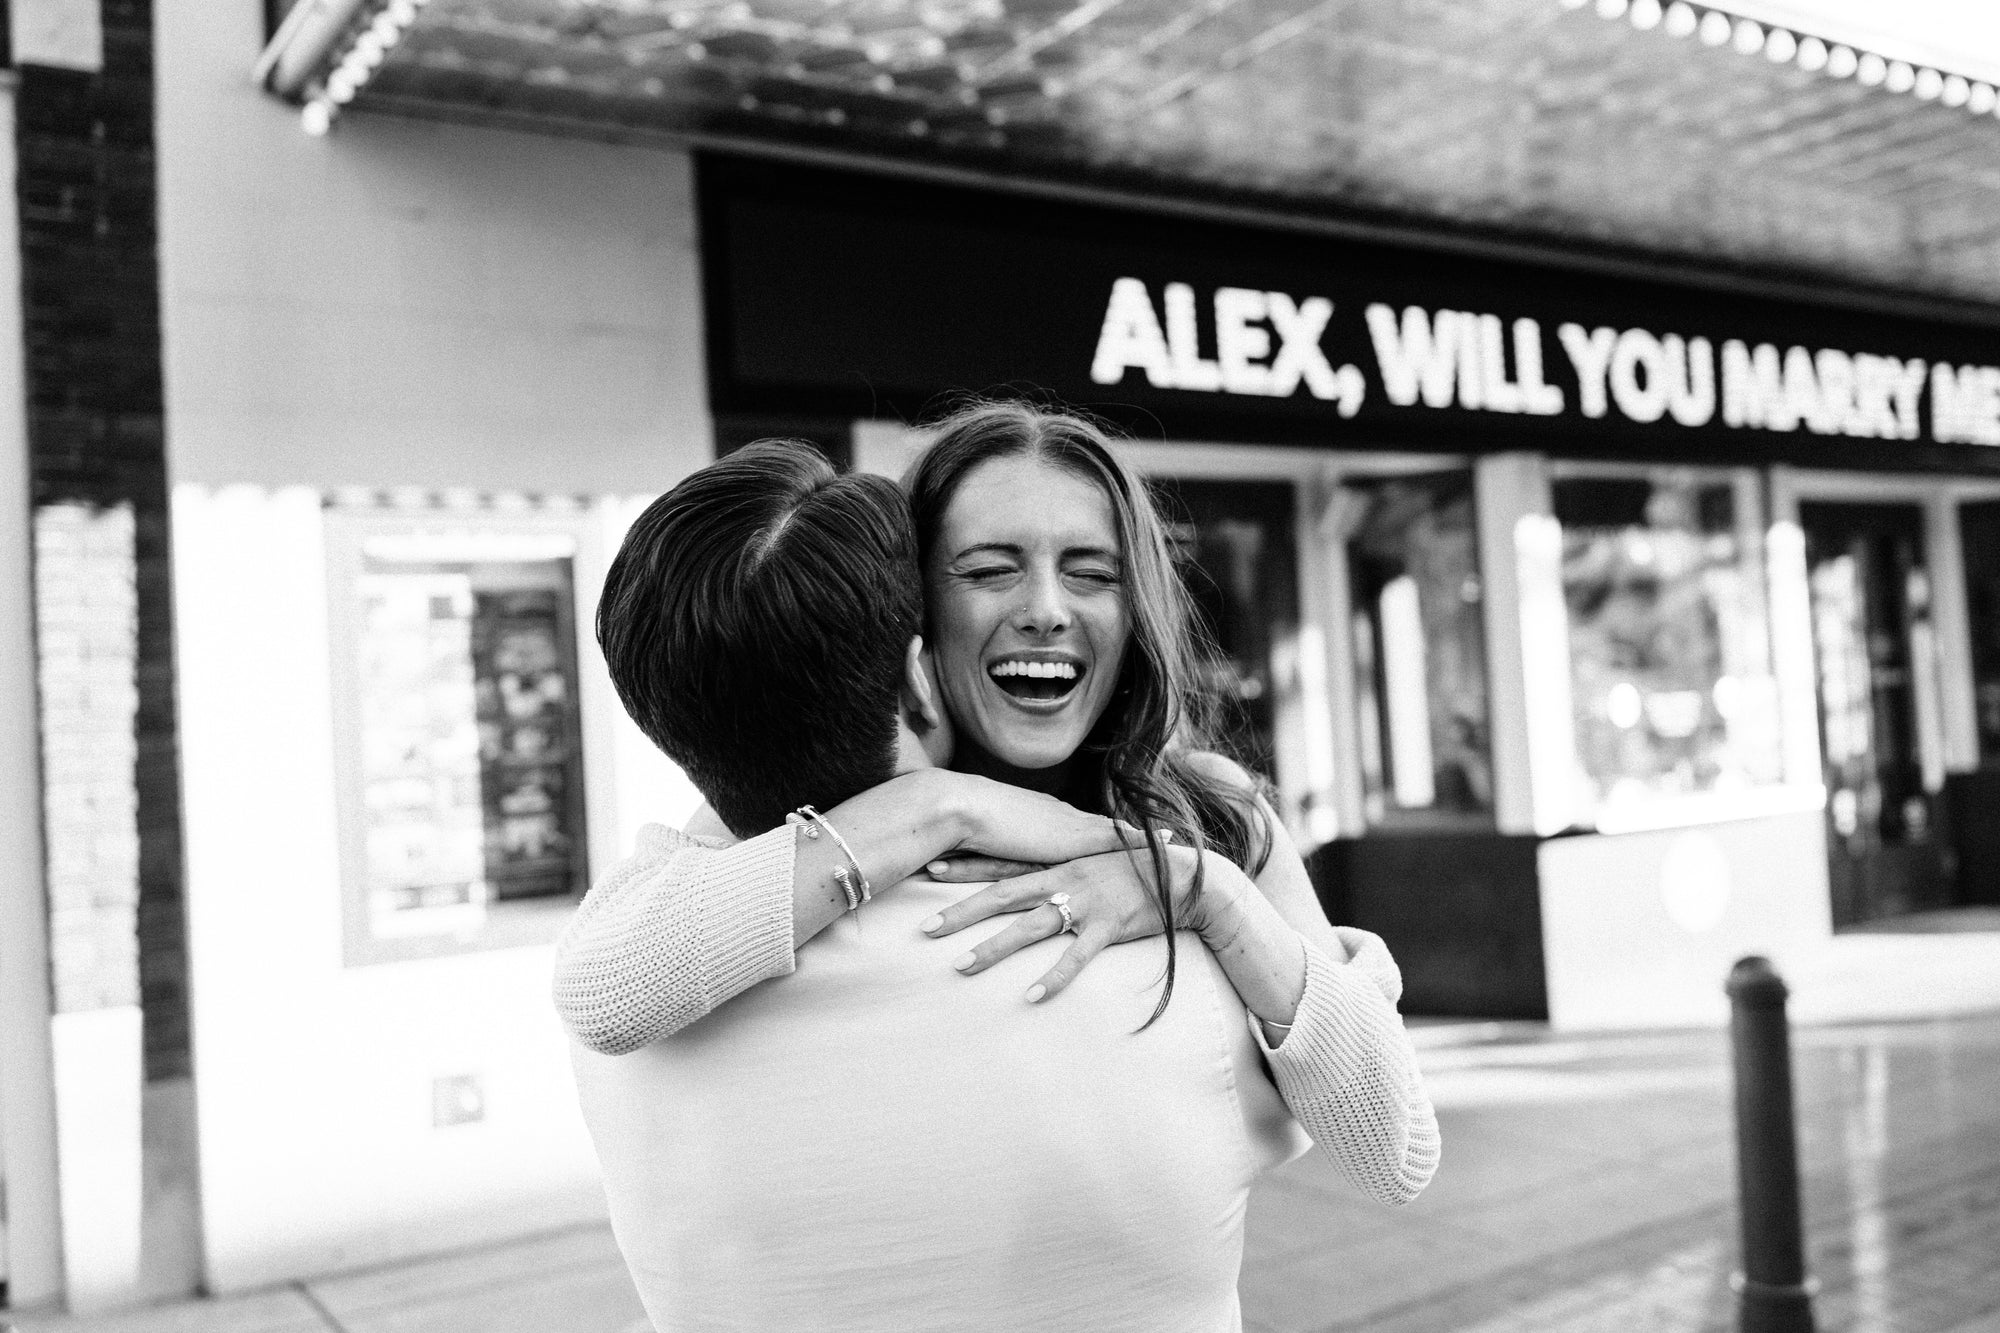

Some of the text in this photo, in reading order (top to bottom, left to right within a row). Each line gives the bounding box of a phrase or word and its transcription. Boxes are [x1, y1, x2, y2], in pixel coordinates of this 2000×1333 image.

[1090, 276, 1366, 418] ALEX,
[1365, 302, 1563, 416] WILL
[1558, 322, 1716, 428] YOU
[1722, 338, 1926, 441] MARRY
